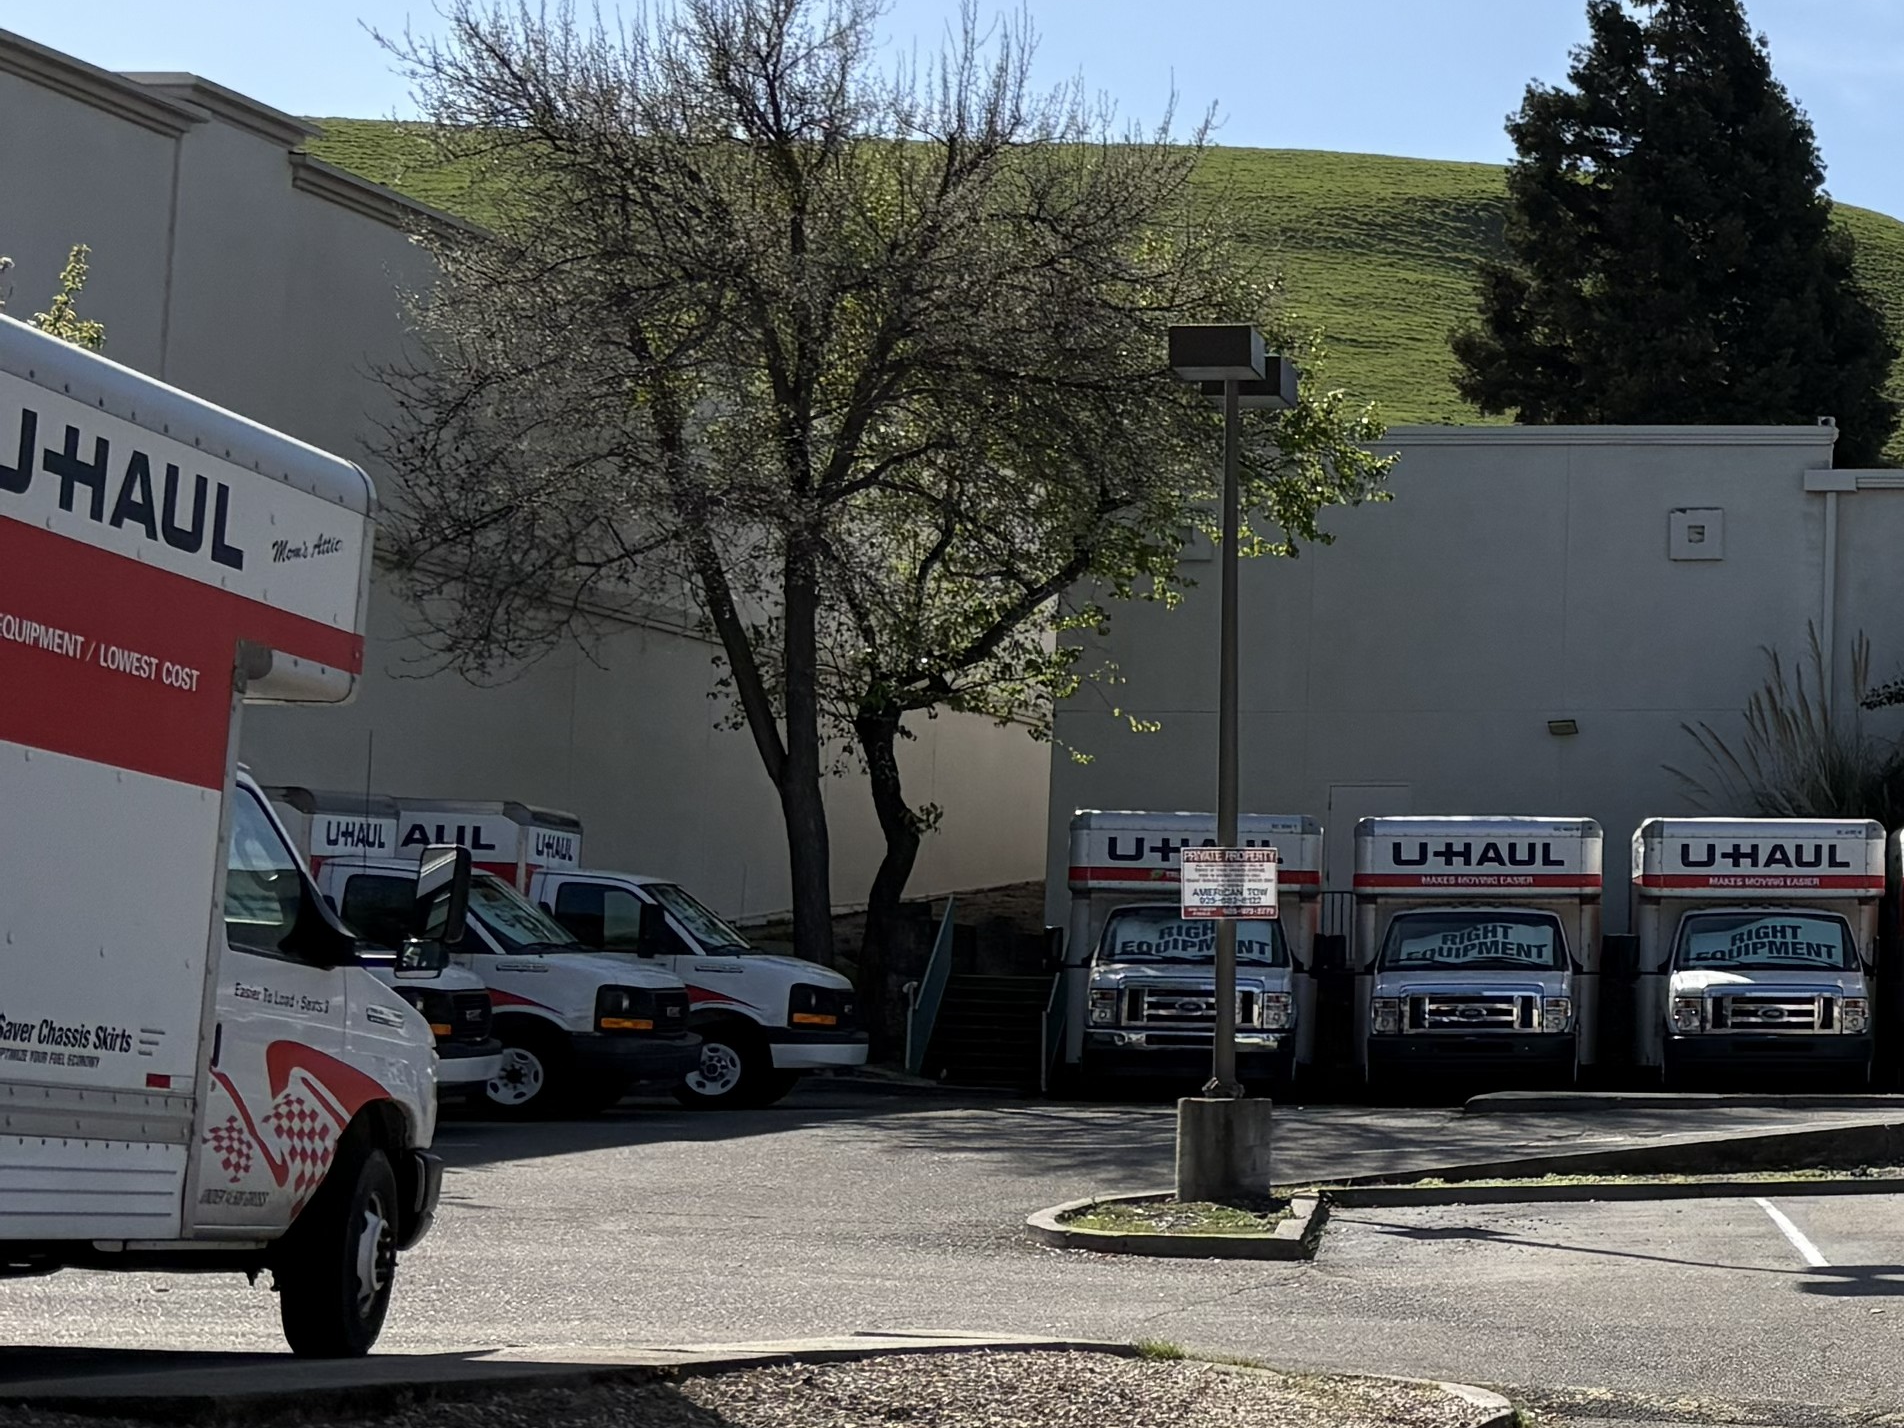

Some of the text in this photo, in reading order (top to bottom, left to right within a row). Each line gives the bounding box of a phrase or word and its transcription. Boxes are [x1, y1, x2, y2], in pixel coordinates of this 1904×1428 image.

[271, 532, 343, 563] Mom's Attic
[99, 643, 159, 681] LOWEST
[162, 662, 201, 692] COST
[326, 820, 386, 850] U-HAUL
[401, 823, 496, 851] AUL
[535, 831, 573, 862] U-HAUL
[1184, 850, 1276, 862] PRIVATE PROPERTY
[1392, 841, 1565, 867] U-HAUL
[1680, 843, 1851, 869] U-HAUL
[1421, 875, 1456, 886] MAKES
[1500, 875, 1534, 886] EASIER
[1709, 876, 1820, 887] MAKES MOVING EASIER
[1158, 922, 1216, 940] RIGH
[1441, 924, 1514, 947] RIGHT
[1730, 924, 1803, 948] RIGHT
[1120, 934, 1271, 956] EQUIPMNT
[1405, 940, 1549, 962] EQUIPMENT
[1695, 940, 1837, 962] EQUIPMENT
[274, 990, 295, 1008] Load
[0, 1013, 133, 1053] Saver Chassis Skirts
